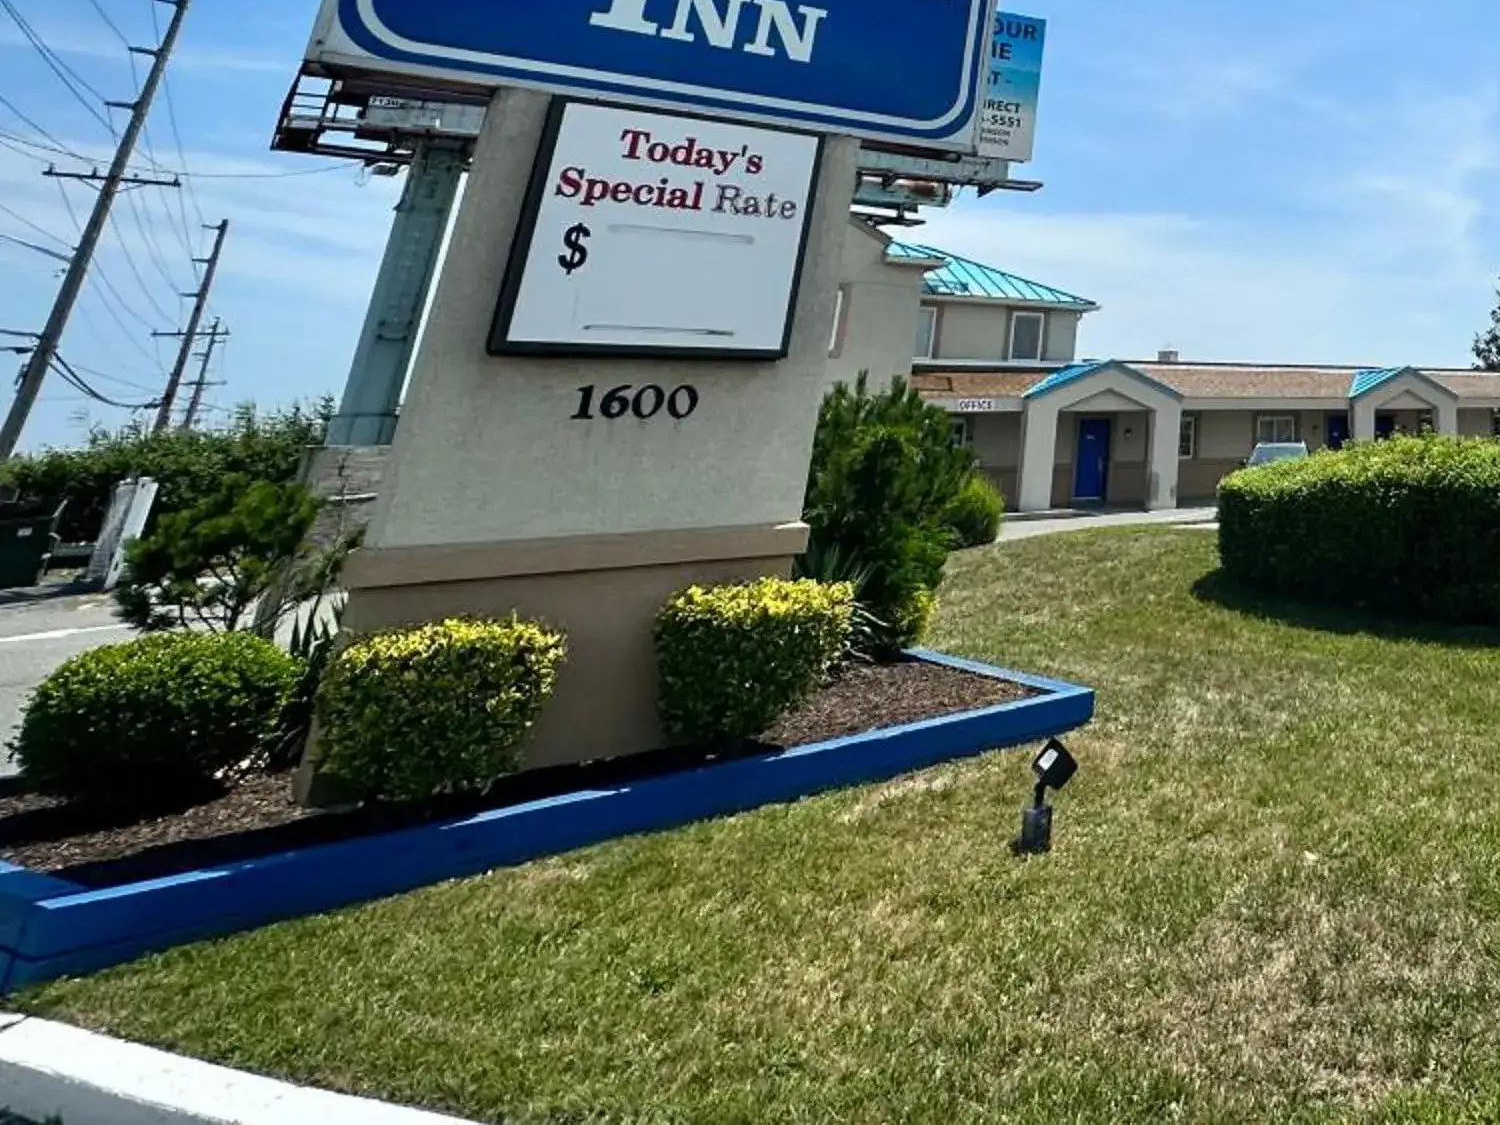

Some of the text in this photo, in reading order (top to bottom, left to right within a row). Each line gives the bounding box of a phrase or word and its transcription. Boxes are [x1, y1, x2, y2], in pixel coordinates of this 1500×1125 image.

[981, 114, 1021, 128] -5551
[620, 129, 763, 175] Today's
[555, 166, 797, 220] Special Rate
[558, 222, 591, 275] $
[570, 384, 699, 420] 1600
